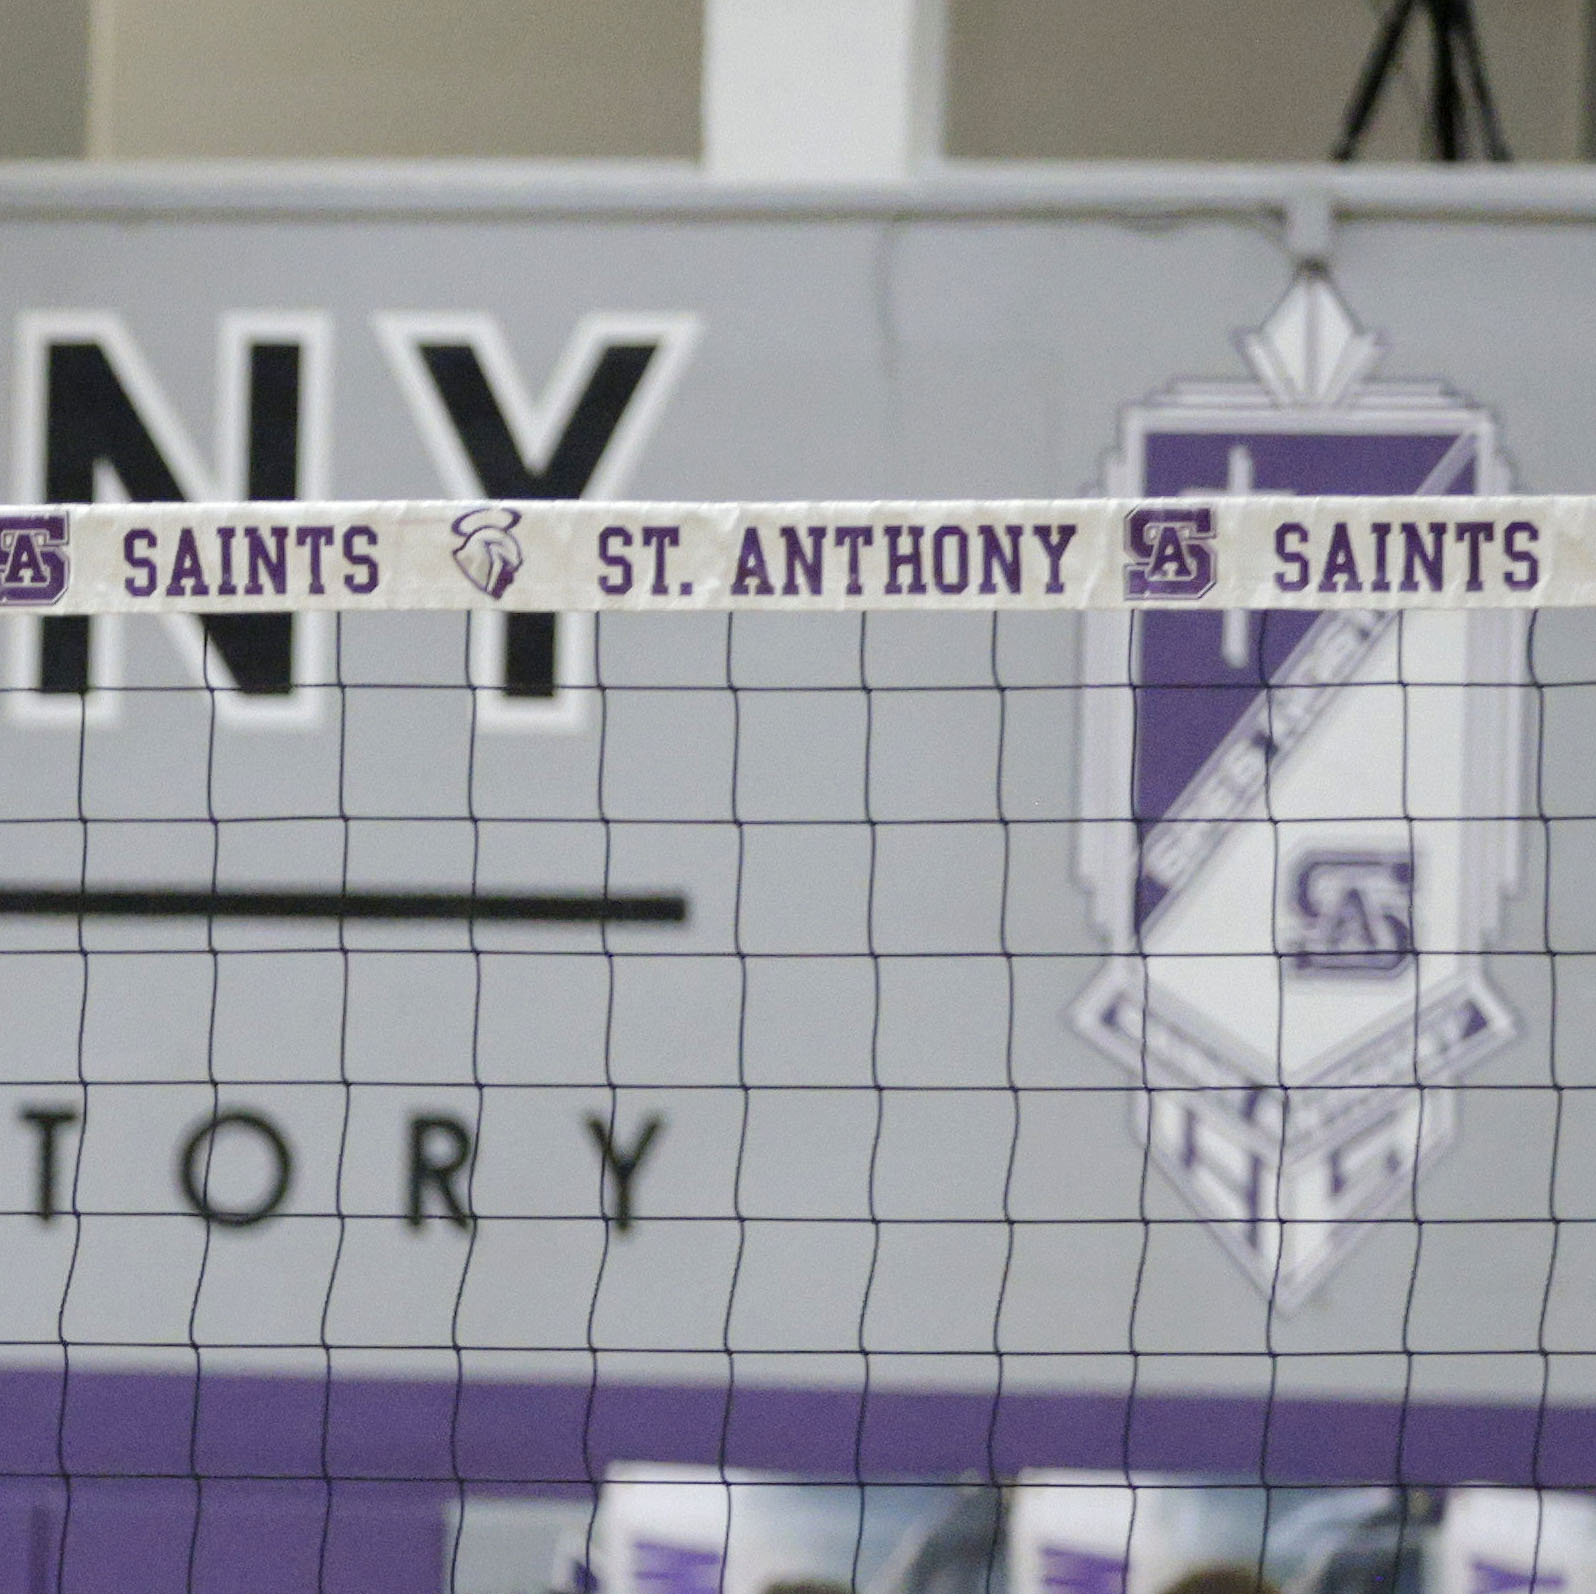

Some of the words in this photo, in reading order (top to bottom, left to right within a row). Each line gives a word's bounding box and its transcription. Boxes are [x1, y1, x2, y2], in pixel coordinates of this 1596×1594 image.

[123, 525, 379, 597] SAINTS
[597, 525, 693, 595] ST.
[730, 523, 1078, 596] ANTHONY
[1274, 521, 1539, 592] SAINTS
